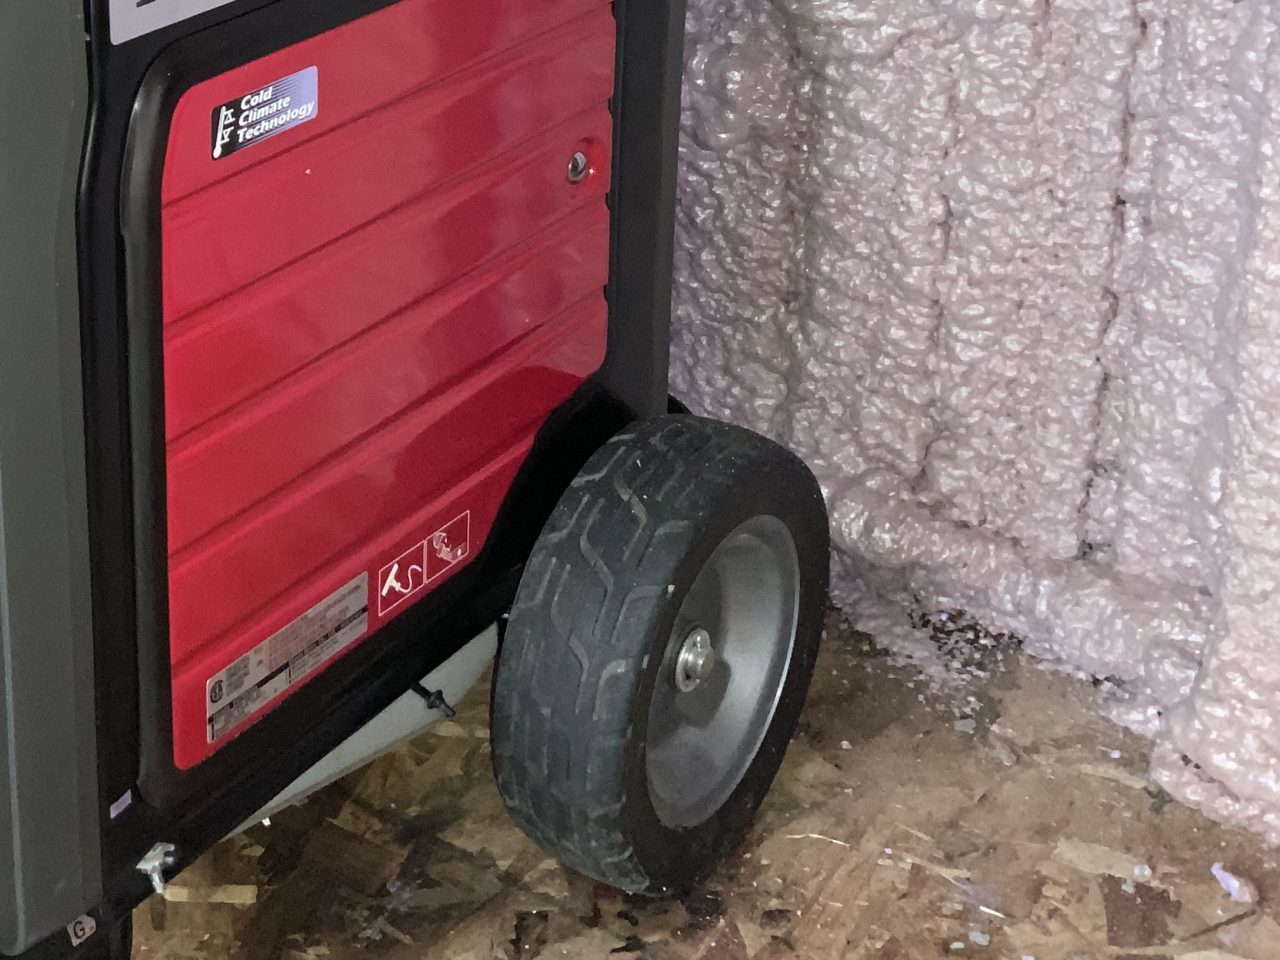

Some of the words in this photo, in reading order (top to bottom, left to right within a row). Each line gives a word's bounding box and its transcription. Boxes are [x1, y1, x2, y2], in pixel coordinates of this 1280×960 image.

[238, 96, 291, 127] Climate
[240, 86, 273, 110] Cold
[236, 100, 315, 143] Technology
[73, 920, 86, 939] G
